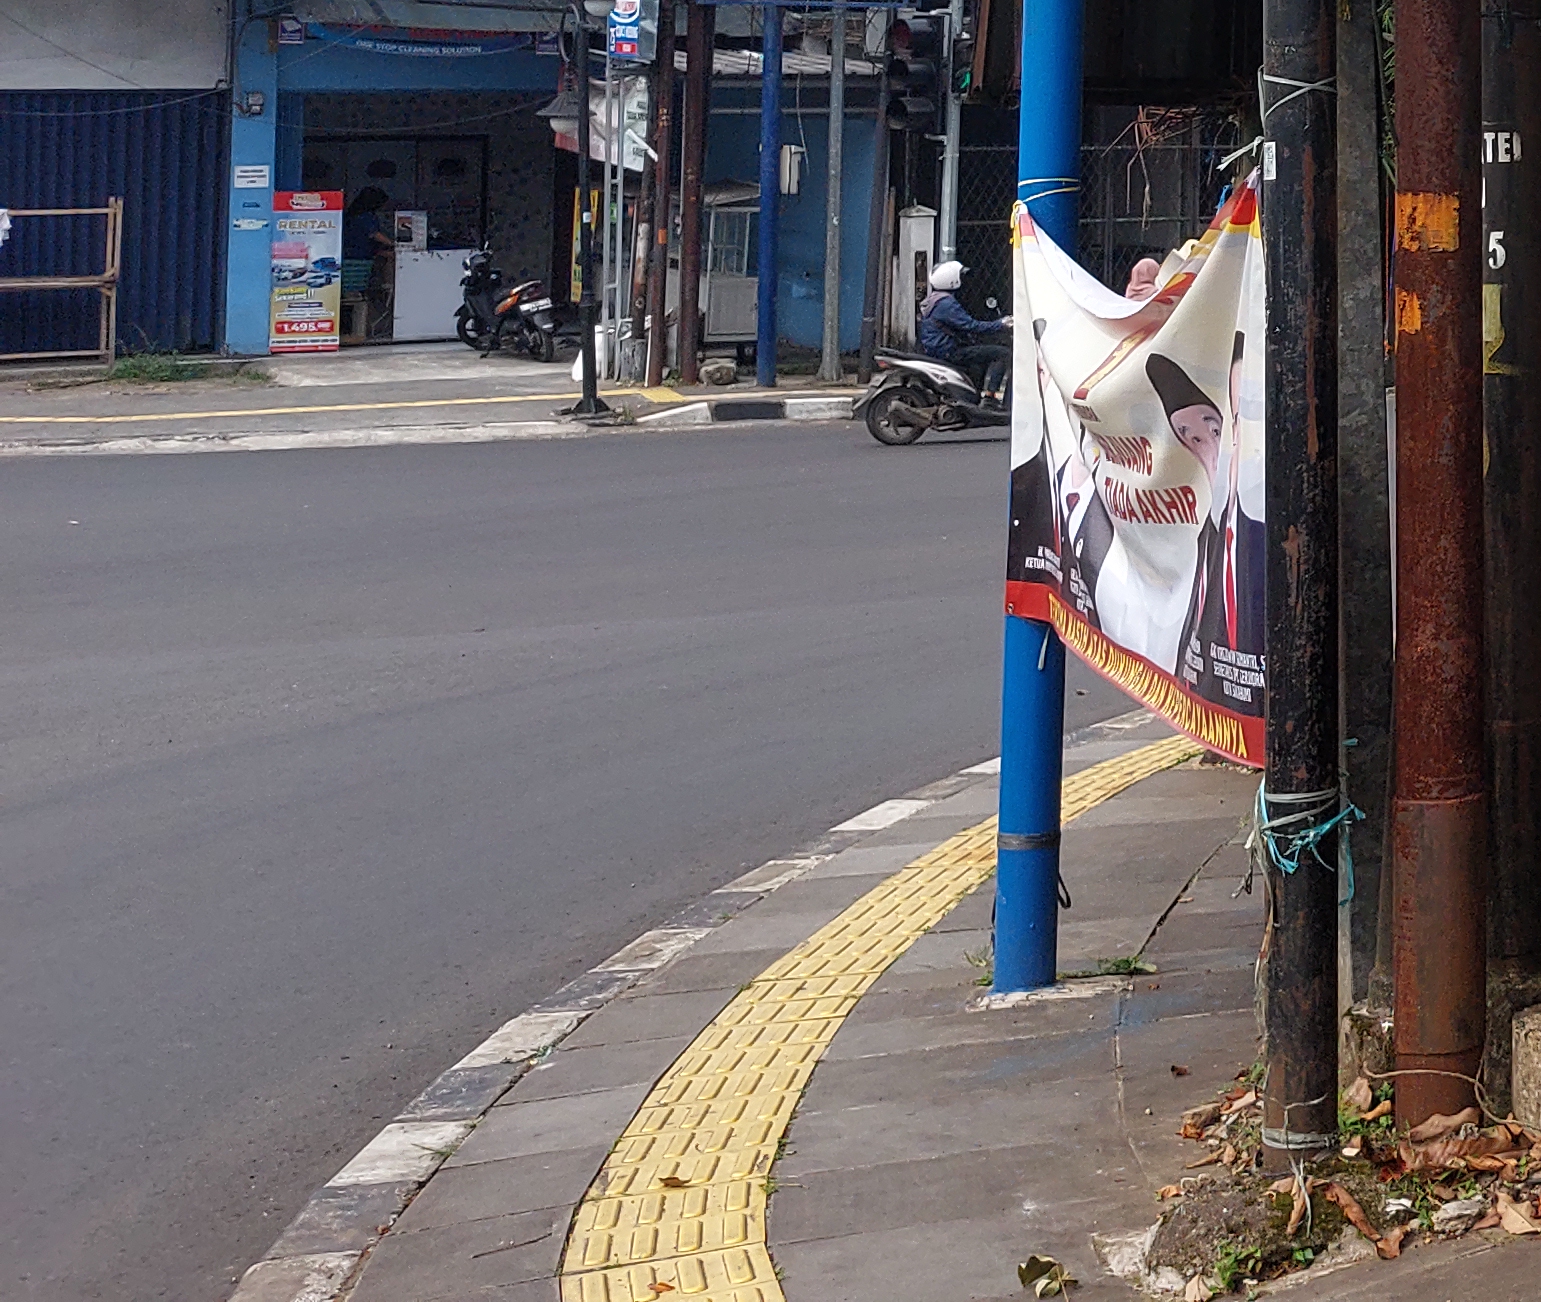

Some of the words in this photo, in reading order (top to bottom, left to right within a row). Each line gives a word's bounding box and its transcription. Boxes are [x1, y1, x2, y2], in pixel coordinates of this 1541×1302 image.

[376, 42, 397, 51] STOP
[277, 219, 338, 230] RENTAL
[1488, 230, 1507, 270] 5
[1104, 476, 1141, 525] TIADA
[1134, 485, 1200, 526] AKHIR
[1066, 611, 1089, 655] KASIH
[1086, 628, 1108, 671] ATAS
